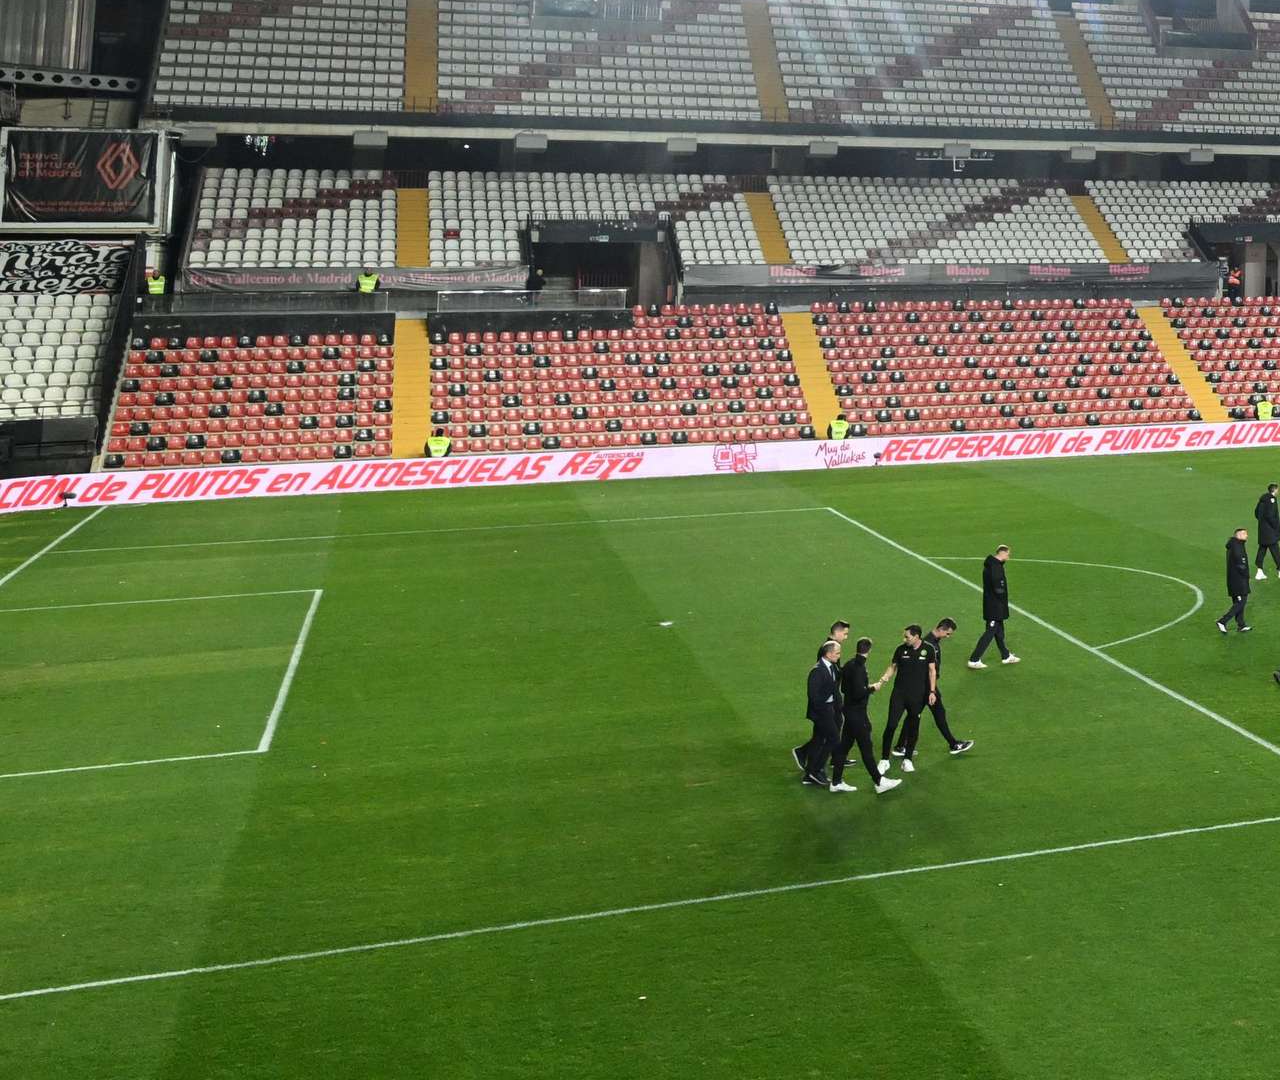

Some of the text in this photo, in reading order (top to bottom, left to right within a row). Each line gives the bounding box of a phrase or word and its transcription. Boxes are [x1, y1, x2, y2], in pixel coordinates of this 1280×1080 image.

[19, 152, 59, 160] nueva
[36, 169, 82, 177] Madrid
[33, 239, 88, 253] vida
[61, 263, 118, 275] vida
[946, 265, 991, 275] Mahou
[1029, 264, 1071, 275] Mahou
[1108, 264, 1151, 274] Mahou
[227, 273, 285, 284] Vallecano
[288, 273, 303, 283] de
[308, 273, 351, 284] Madrid
[379, 273, 405, 285] Rayo
[468, 272, 481, 282] de
[486, 272, 530, 282] Madrid
[1060, 431, 1091, 453] de
[1095, 427, 1186, 451] PUNTOS
[1185, 429, 1215, 447] en
[815, 440, 850, 456] Muy de
[596, 451, 645, 459] AUTOESCUELAS
[0, 451, 643, 509] CIÓN de PUNTOS en AUTOESCUELAS Rayo
